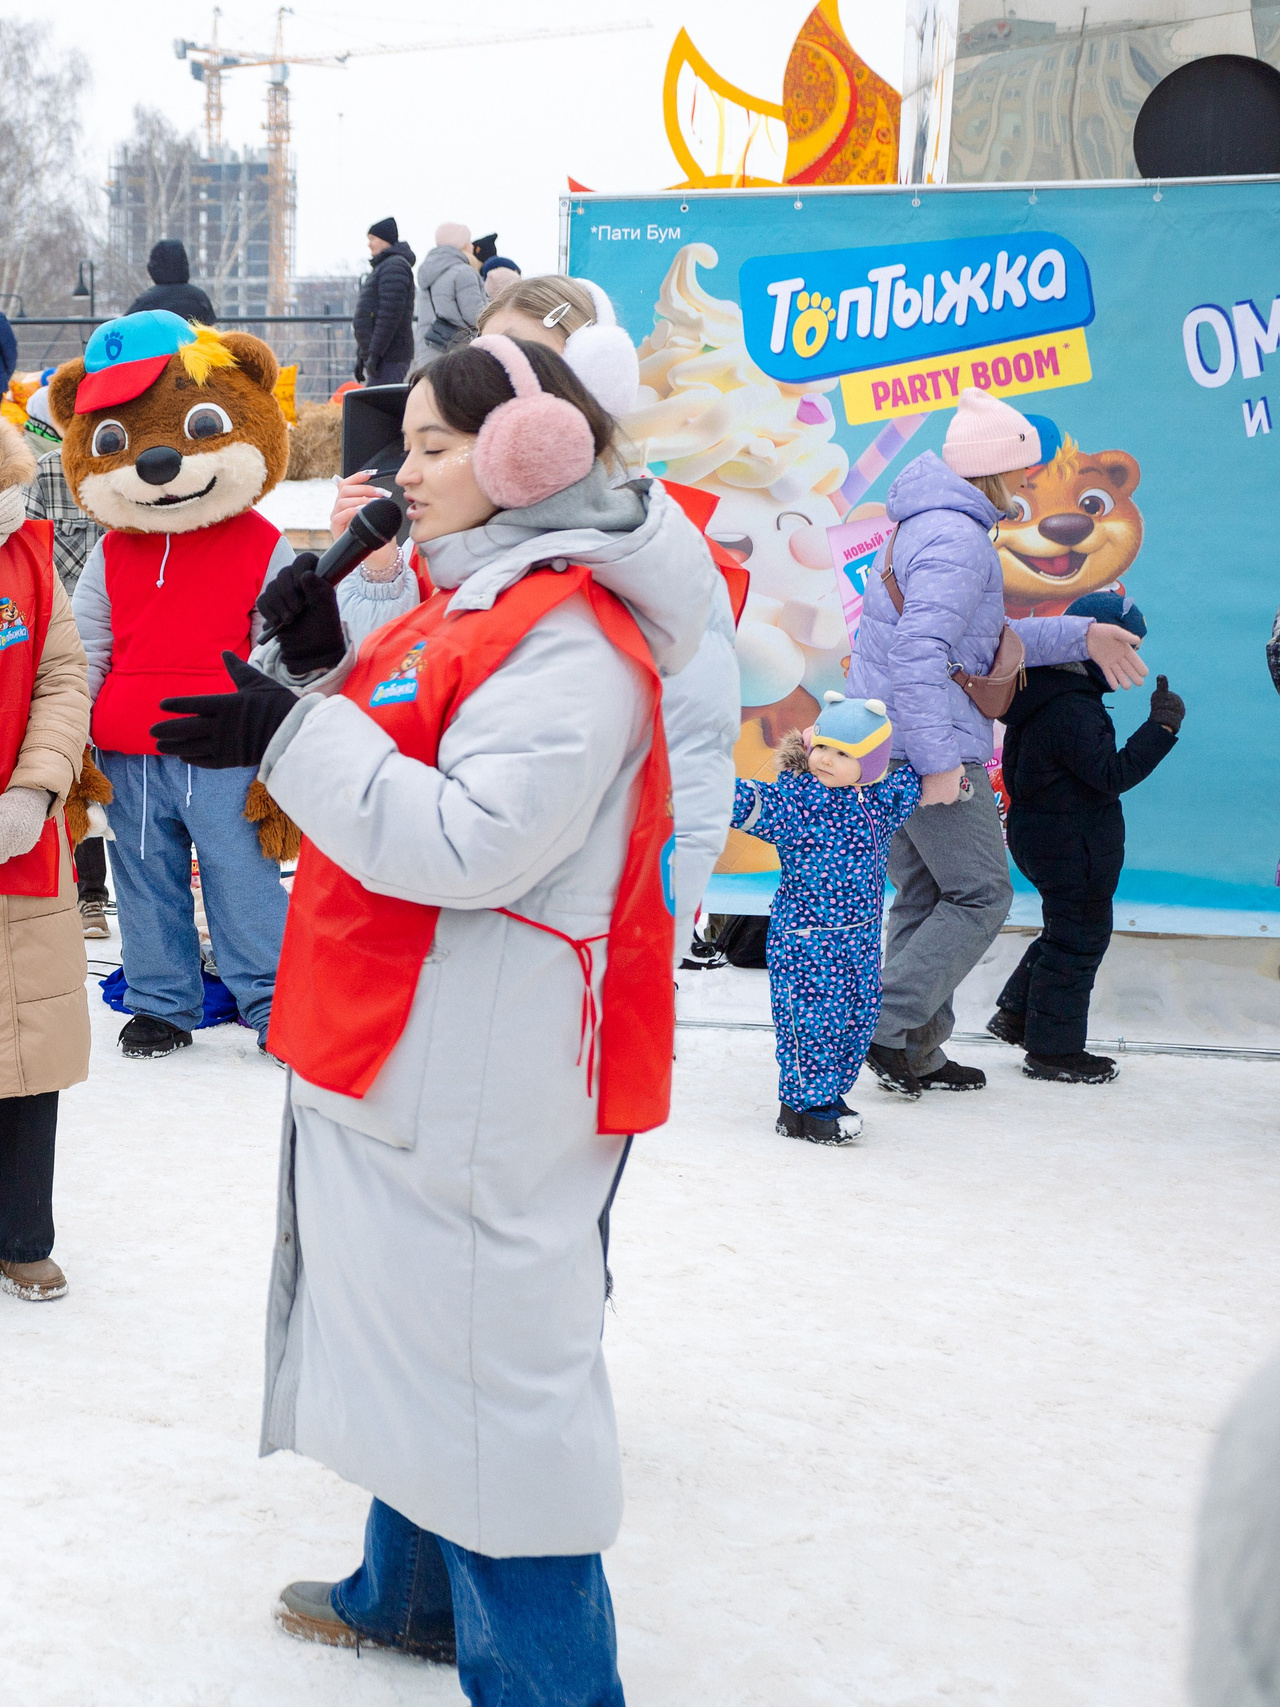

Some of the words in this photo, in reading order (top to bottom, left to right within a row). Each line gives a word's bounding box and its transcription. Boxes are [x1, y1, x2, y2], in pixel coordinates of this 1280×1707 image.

[646, 224, 681, 244] Бум
[871, 366, 960, 412] PARTY
[843, 532, 885, 561] НОВЫЙ
